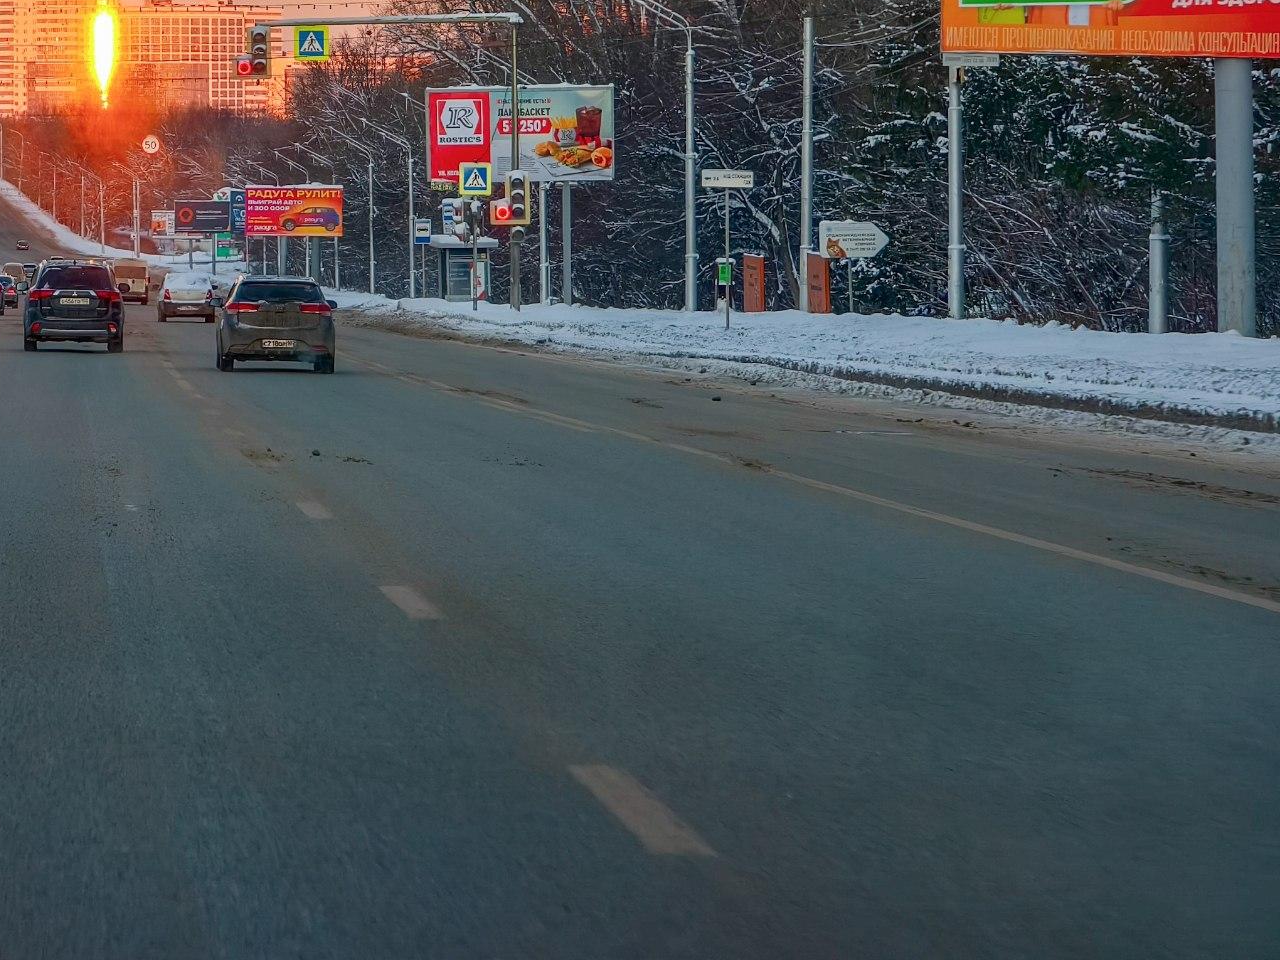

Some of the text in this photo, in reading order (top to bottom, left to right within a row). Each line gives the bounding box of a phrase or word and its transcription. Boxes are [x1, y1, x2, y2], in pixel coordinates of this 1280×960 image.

[947, 27, 998, 47] ИМЕЮТСЯ
[1120, 29, 1195, 52] НЕОБХОДИМА
[145, 140, 156, 149] 50
[248, 189, 340, 198] РАДУГА РУЛИТ!
